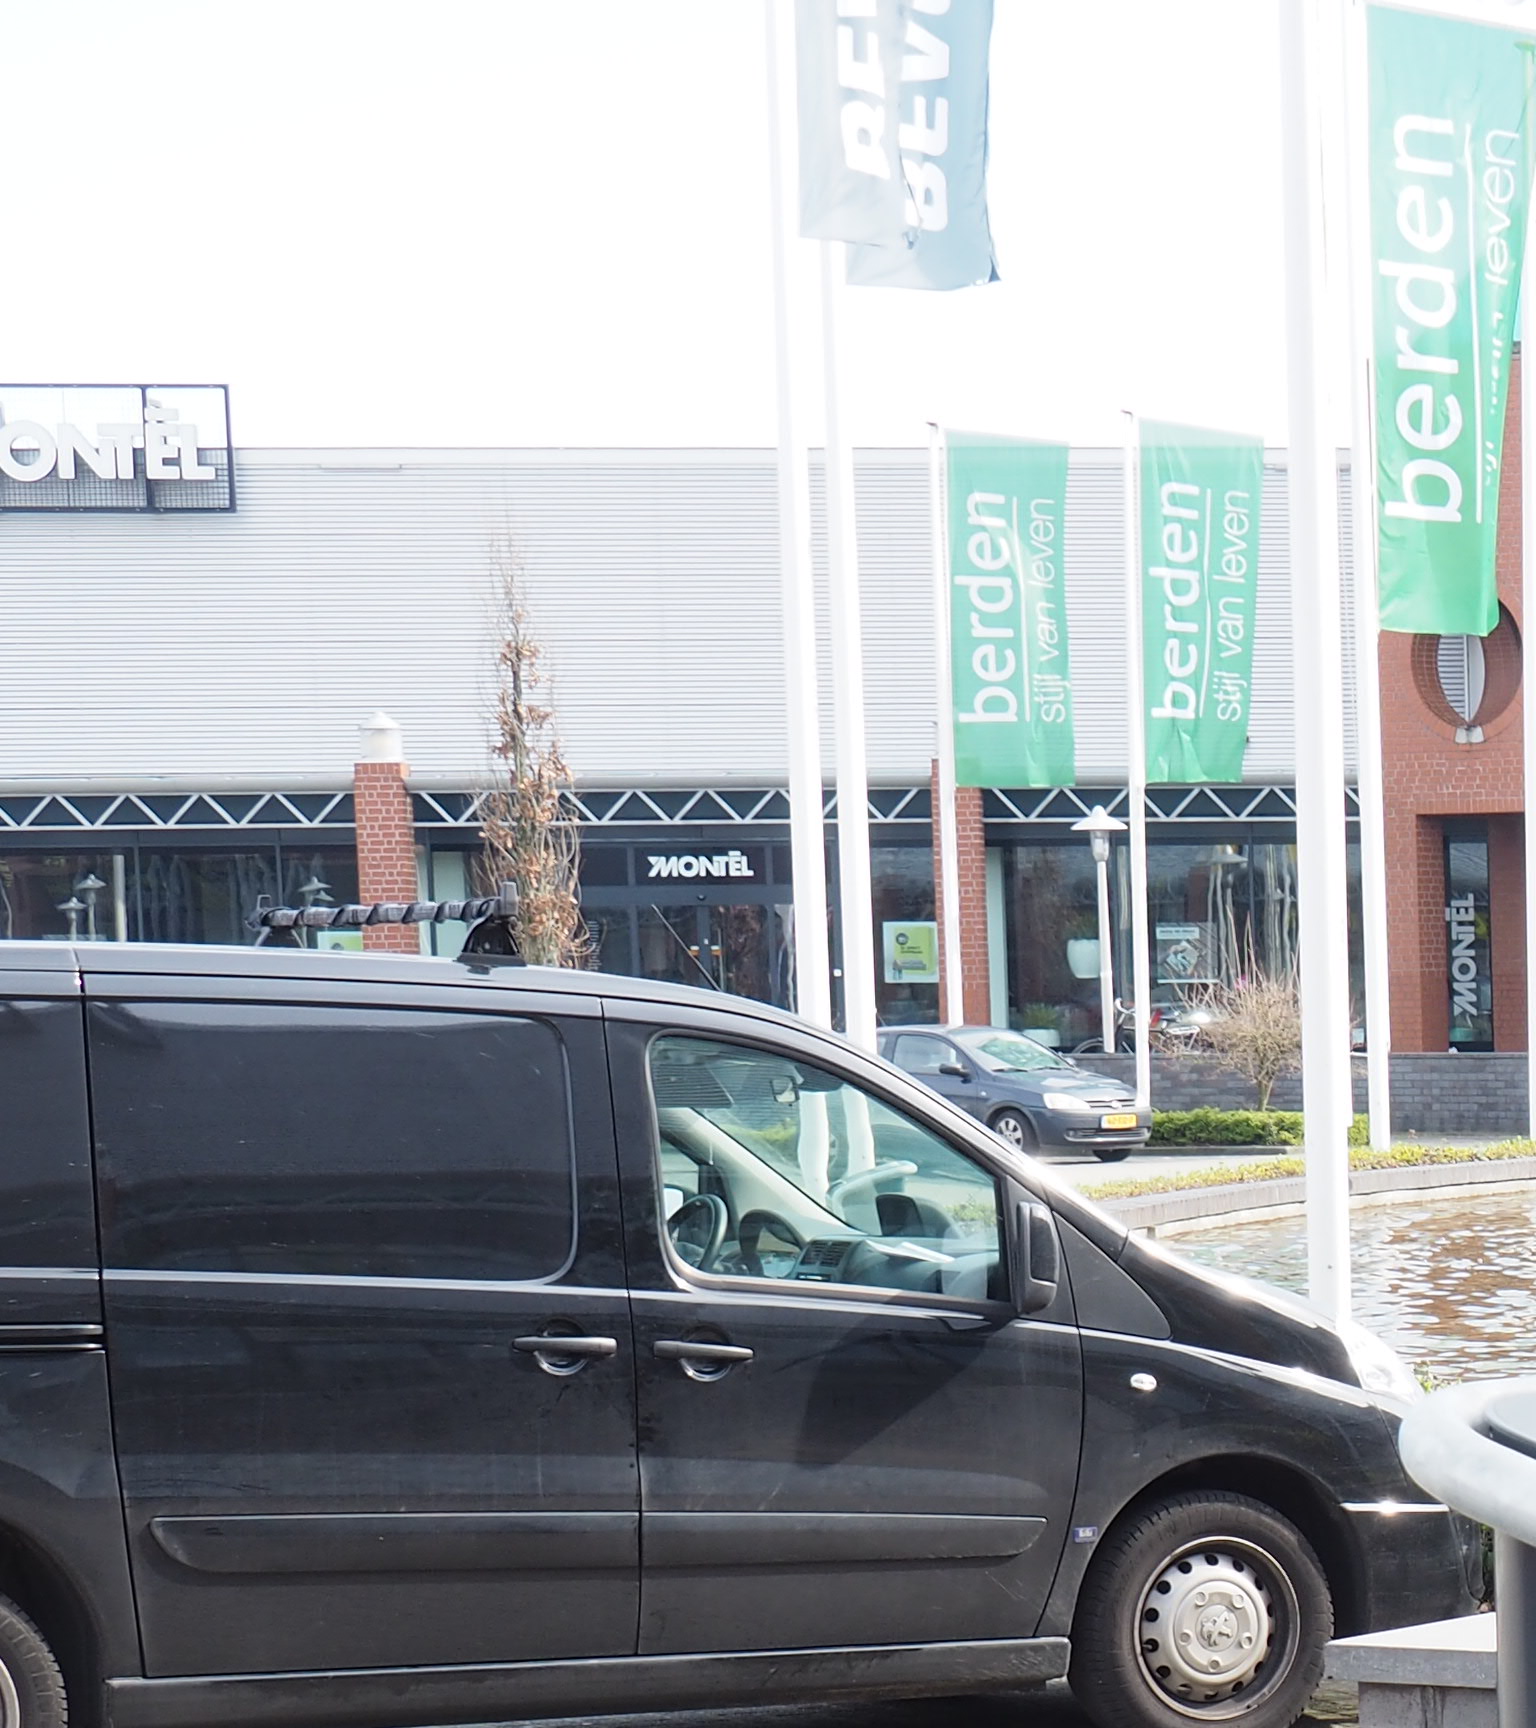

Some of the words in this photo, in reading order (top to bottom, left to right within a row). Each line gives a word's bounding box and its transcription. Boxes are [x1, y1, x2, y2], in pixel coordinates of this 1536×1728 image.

[836, 0, 891, 180] RE
[899, 0, 950, 231] BEV
[1484, 129, 1520, 286] leven
[1378, 114, 1463, 522] berden
[1028, 498, 1056, 588] leven
[1212, 489, 1250, 583] leven
[954, 492, 1018, 722] berden
[1036, 602, 1059, 661] van
[1148, 482, 1201, 719] berden
[1217, 597, 1245, 658] van
[1033, 674, 1072, 723] stijl
[1213, 671, 1248, 721] stijl
